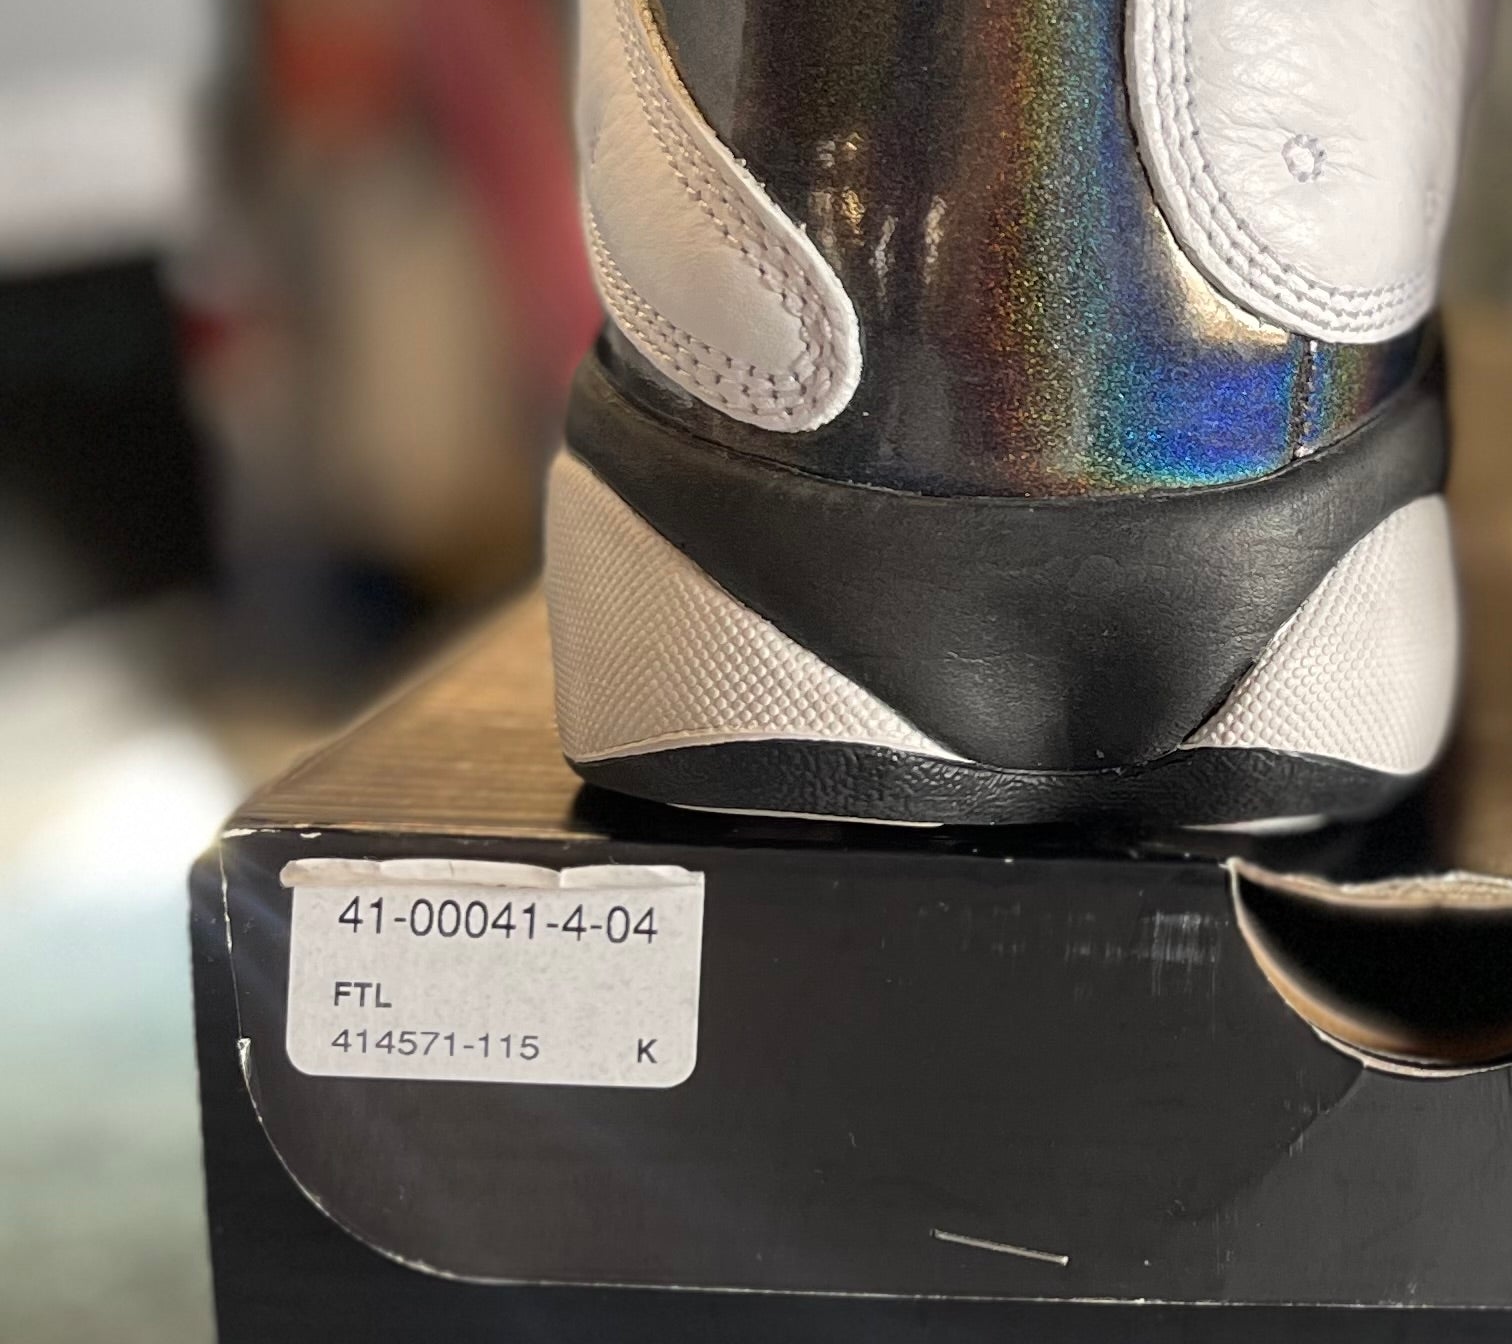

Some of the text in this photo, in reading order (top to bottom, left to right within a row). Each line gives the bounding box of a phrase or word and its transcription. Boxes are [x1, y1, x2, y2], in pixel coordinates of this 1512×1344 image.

[339, 896, 659, 945] 41-00041-4-04
[334, 982, 393, 1008] FTL
[331, 1030, 540, 1061] 414571-115
[637, 1039, 658, 1064] K
